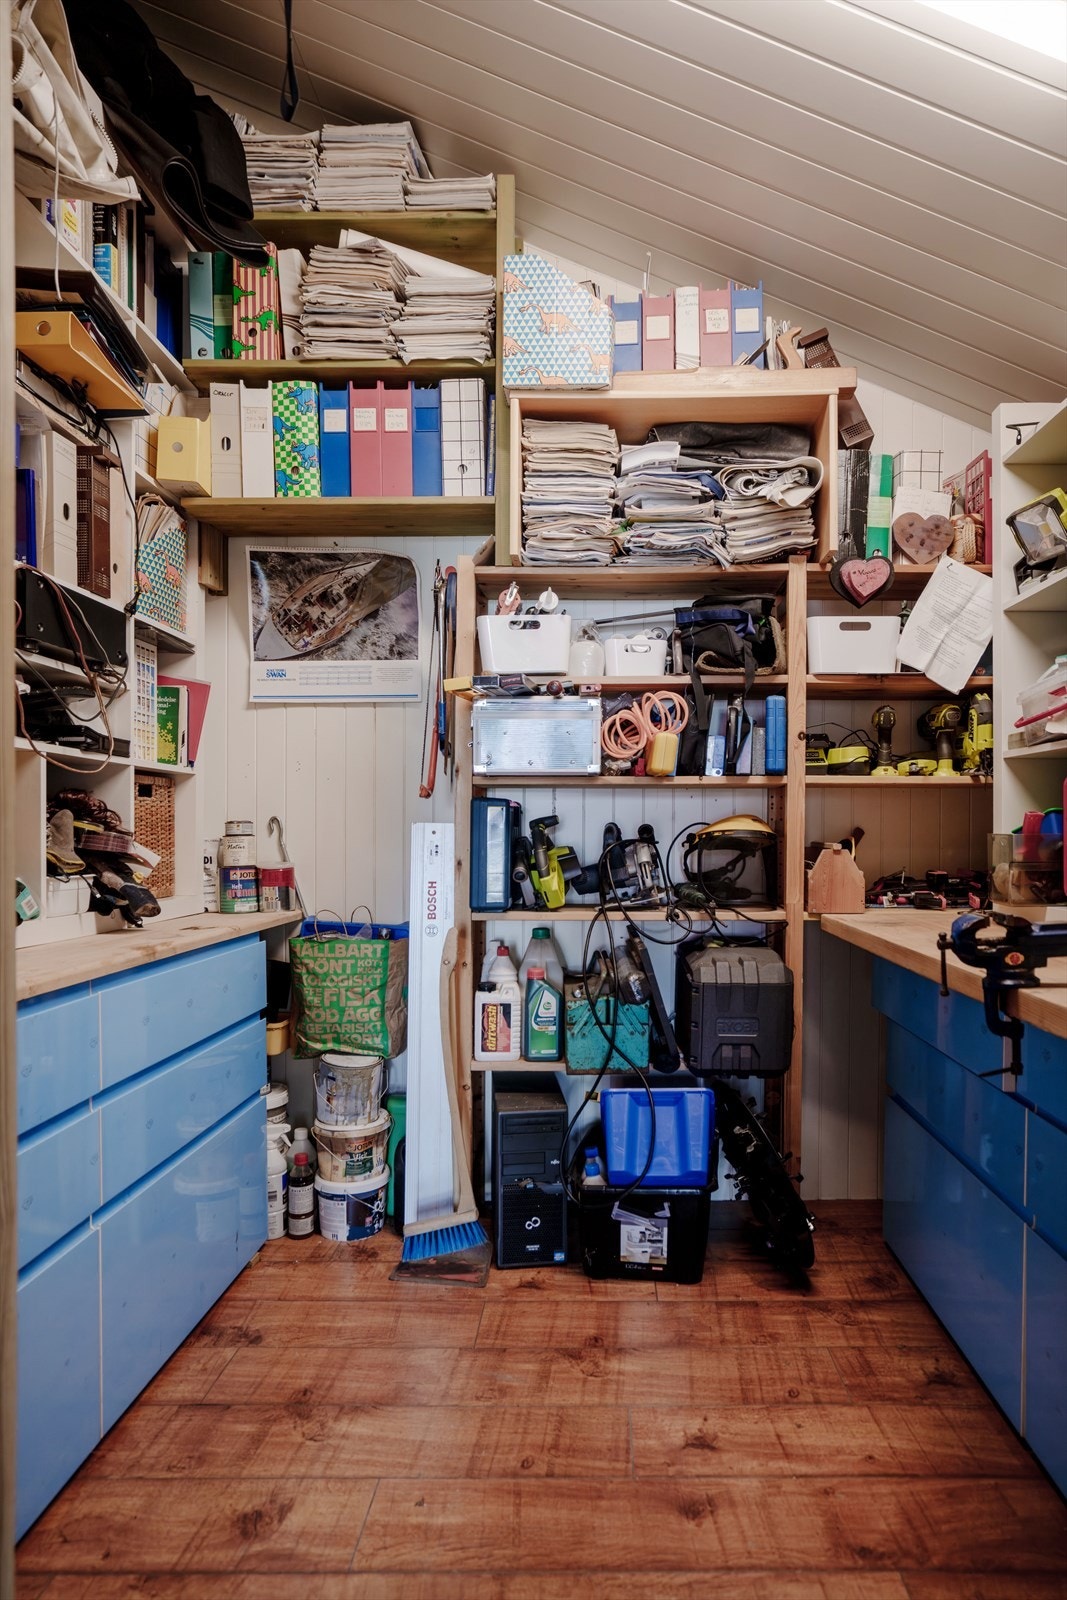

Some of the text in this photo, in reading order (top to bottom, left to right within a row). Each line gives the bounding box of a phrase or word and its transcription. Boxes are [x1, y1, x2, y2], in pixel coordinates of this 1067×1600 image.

[239, 871, 257, 879] JOTU
[427, 881, 437, 920] BOSCH
[324, 988, 382, 1007] FISK
[342, 1007, 381, 1023] ÄGG
[486, 1005, 497, 1051] dirtwash
[340, 1033, 383, 1045] KORV
